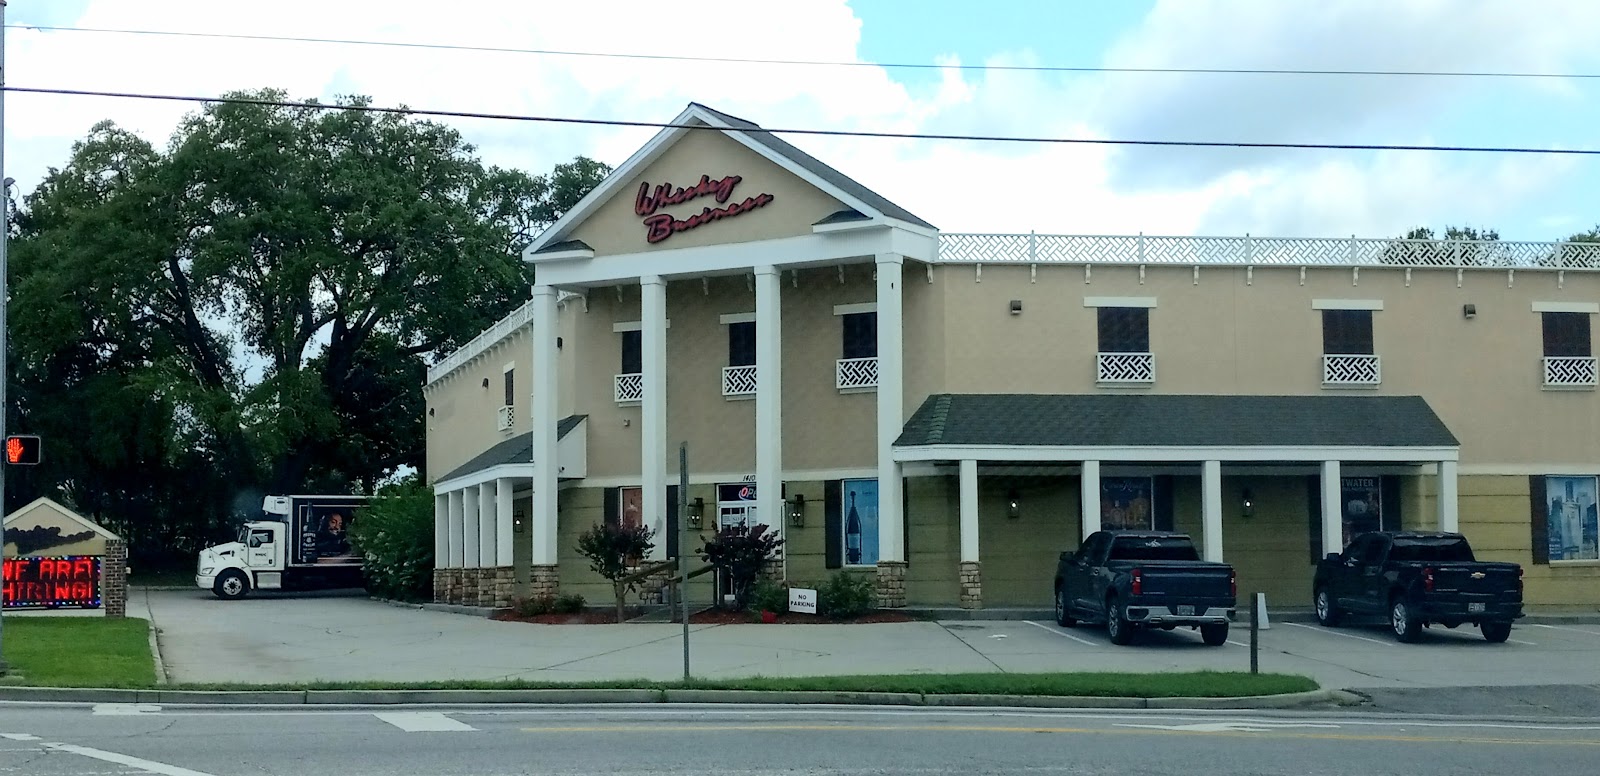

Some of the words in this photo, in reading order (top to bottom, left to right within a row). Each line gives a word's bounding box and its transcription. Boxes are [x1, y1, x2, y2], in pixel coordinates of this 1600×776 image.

[634, 174, 742, 216] Whiskey
[643, 193, 774, 244] Business
[1341, 479, 1374, 487] TWATER
[790, 600, 815, 608] PARKING
